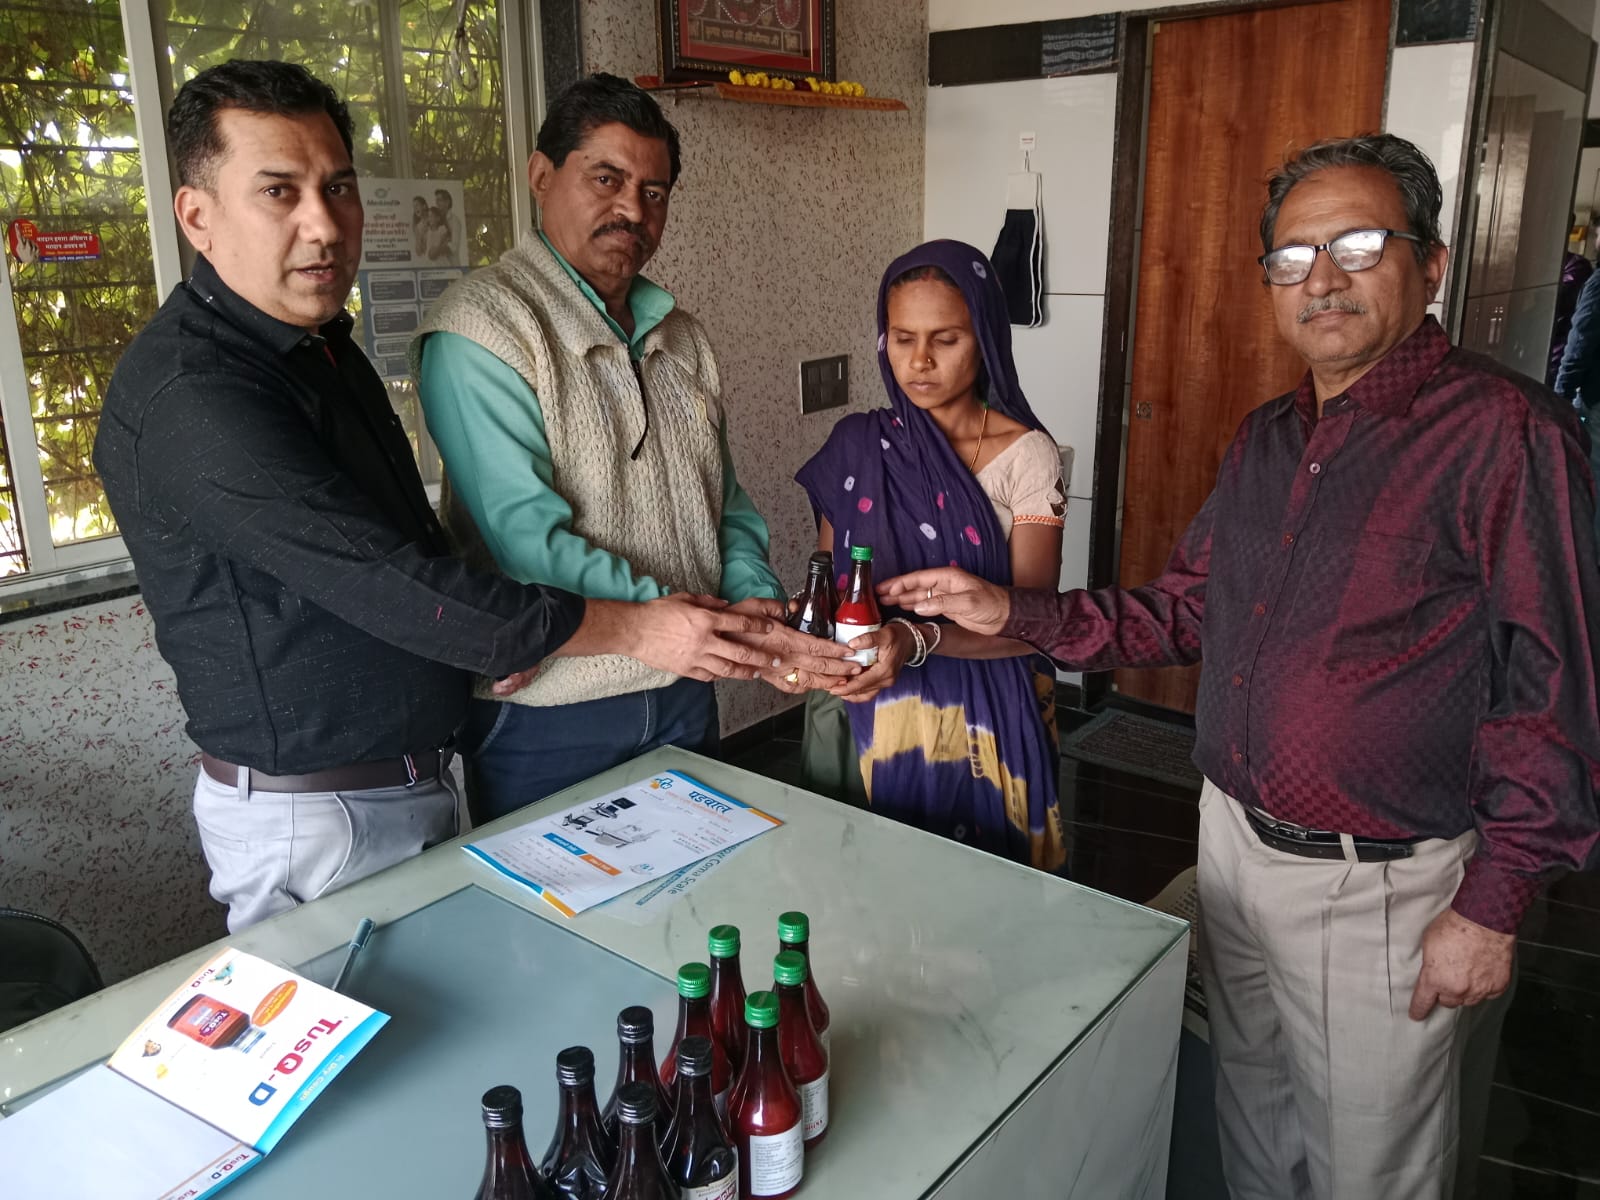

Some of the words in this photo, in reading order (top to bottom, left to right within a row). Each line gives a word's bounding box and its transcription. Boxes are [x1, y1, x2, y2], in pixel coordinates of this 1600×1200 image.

[692, 858, 721, 877] Coma
[668, 877, 697, 895] Scale
[248, 1018, 343, 1107] TusQ-D
[322, 1062, 338, 1076] Dry
[300, 1076, 325, 1101] Cough
[211, 1153, 249, 1180] TusQ-D
